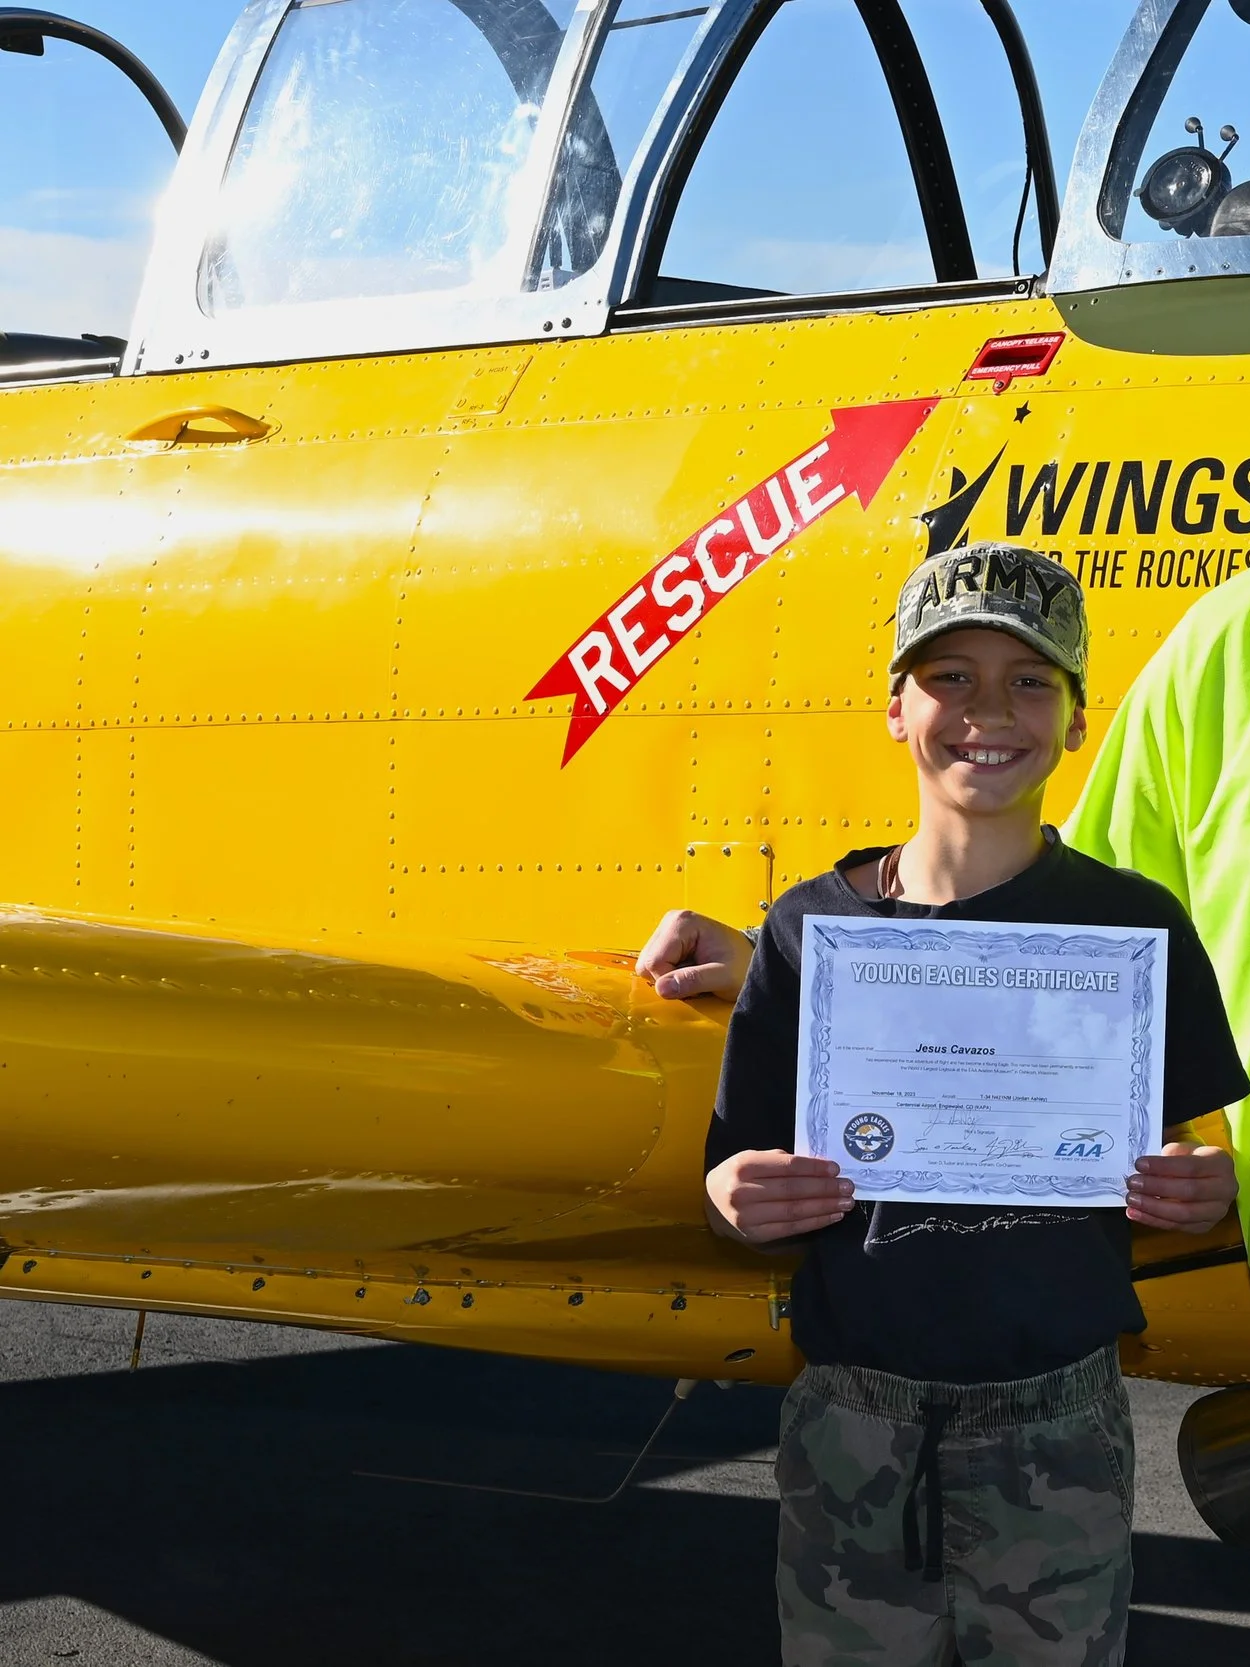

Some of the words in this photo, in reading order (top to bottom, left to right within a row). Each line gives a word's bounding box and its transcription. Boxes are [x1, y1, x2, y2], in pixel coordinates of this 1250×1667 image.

[990, 339, 1022, 349] CANOPY
[971, 365, 1021, 375] EMERGENCY
[567, 440, 845, 715] RESCUE
[1076, 549, 1127, 588] THE
[915, 554, 1066, 629] ARMY
[851, 962, 921, 984] YOUNG
[925, 964, 999, 987] EAGLES
[1002, 967, 1119, 992] CERTIFICATE
[915, 1044, 947, 1054] Jesus
[950, 1044, 996, 1056] Cavazos
[848, 1115, 869, 1132] YOUNG
[870, 1115, 890, 1133] EAGLES
[1054, 1142, 1102, 1158] EAA
